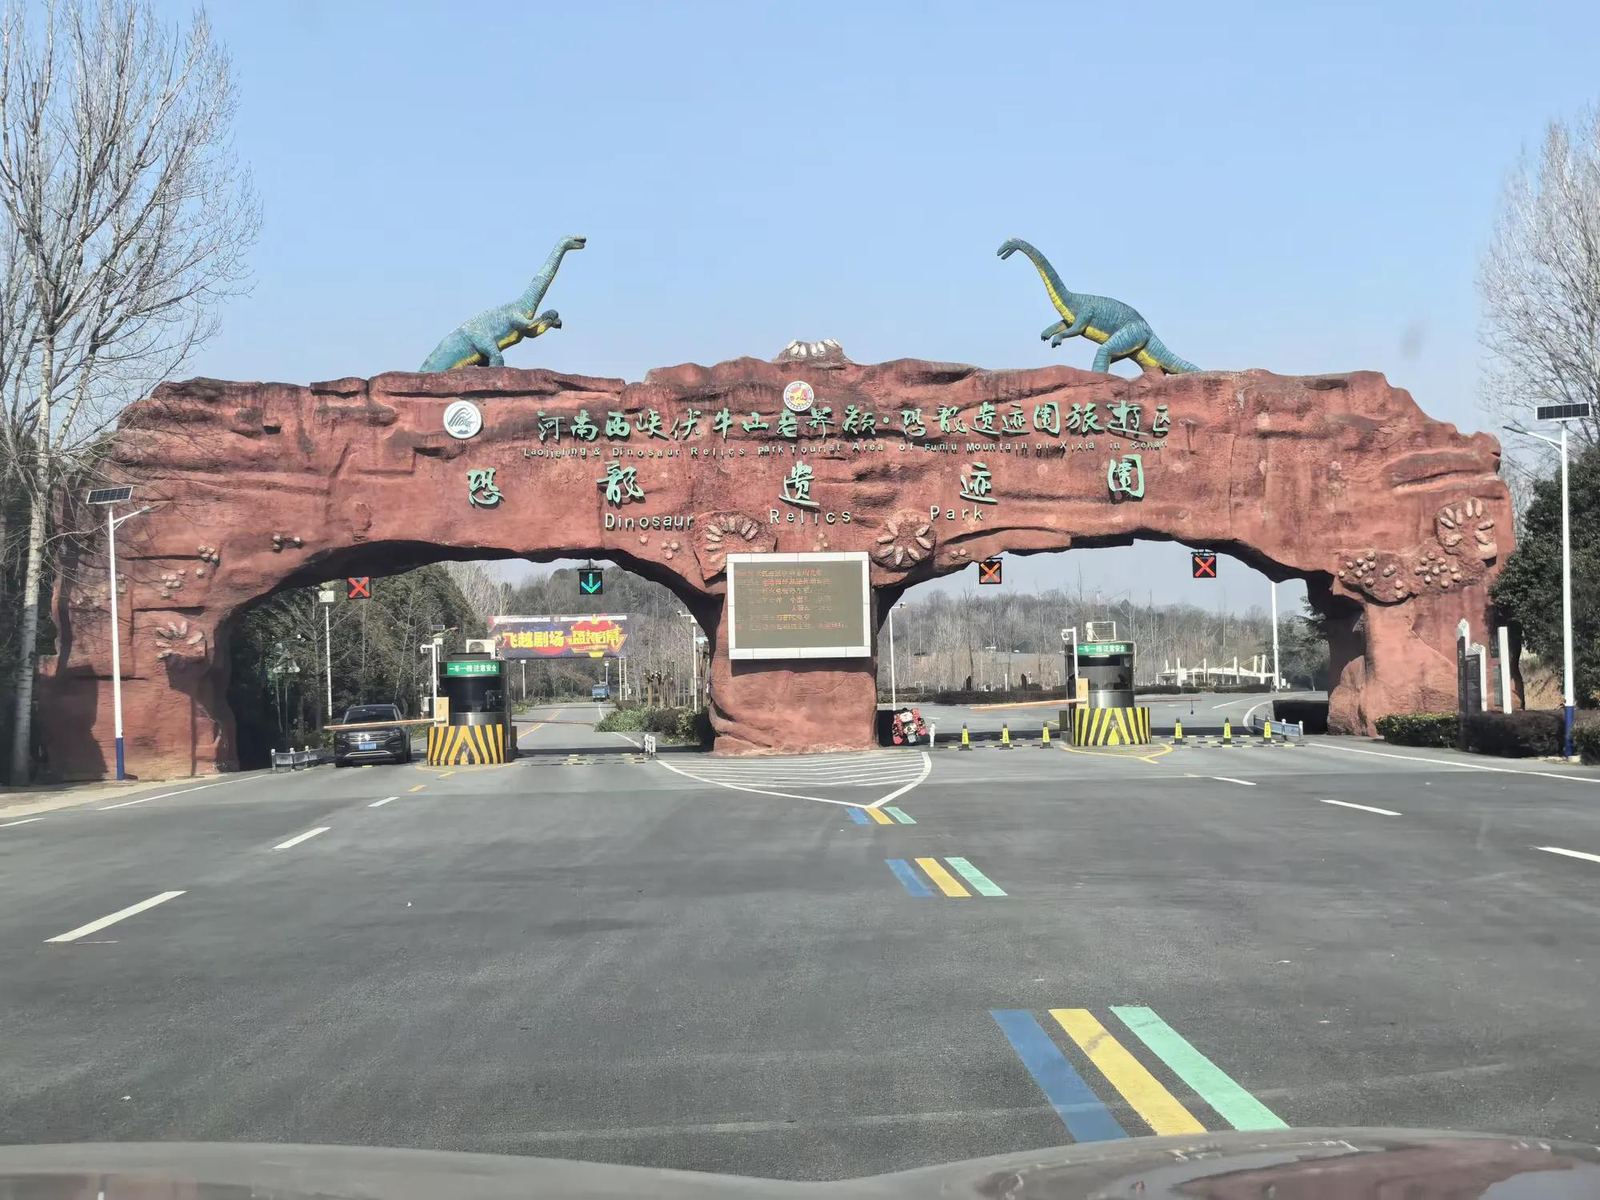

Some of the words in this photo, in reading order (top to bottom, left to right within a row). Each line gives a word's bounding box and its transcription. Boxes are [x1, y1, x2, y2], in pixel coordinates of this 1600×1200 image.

[594, 447, 600, 455] &
[612, 447, 680, 457] Dinosaur
[691, 447, 744, 456] Relics
[790, 444, 840, 454] Tourist
[852, 442, 883, 451] Area
[899, 442, 913, 451] of
[924, 442, 957, 451] Funiu
[966, 440, 1027, 450] Mountain
[1060, 440, 1095, 449] Xixia
[1110, 439, 1120, 449] in
[604, 513, 694, 529] Dinosaur
[769, 509, 851, 525] Relics
[930, 505, 983, 521] Park
